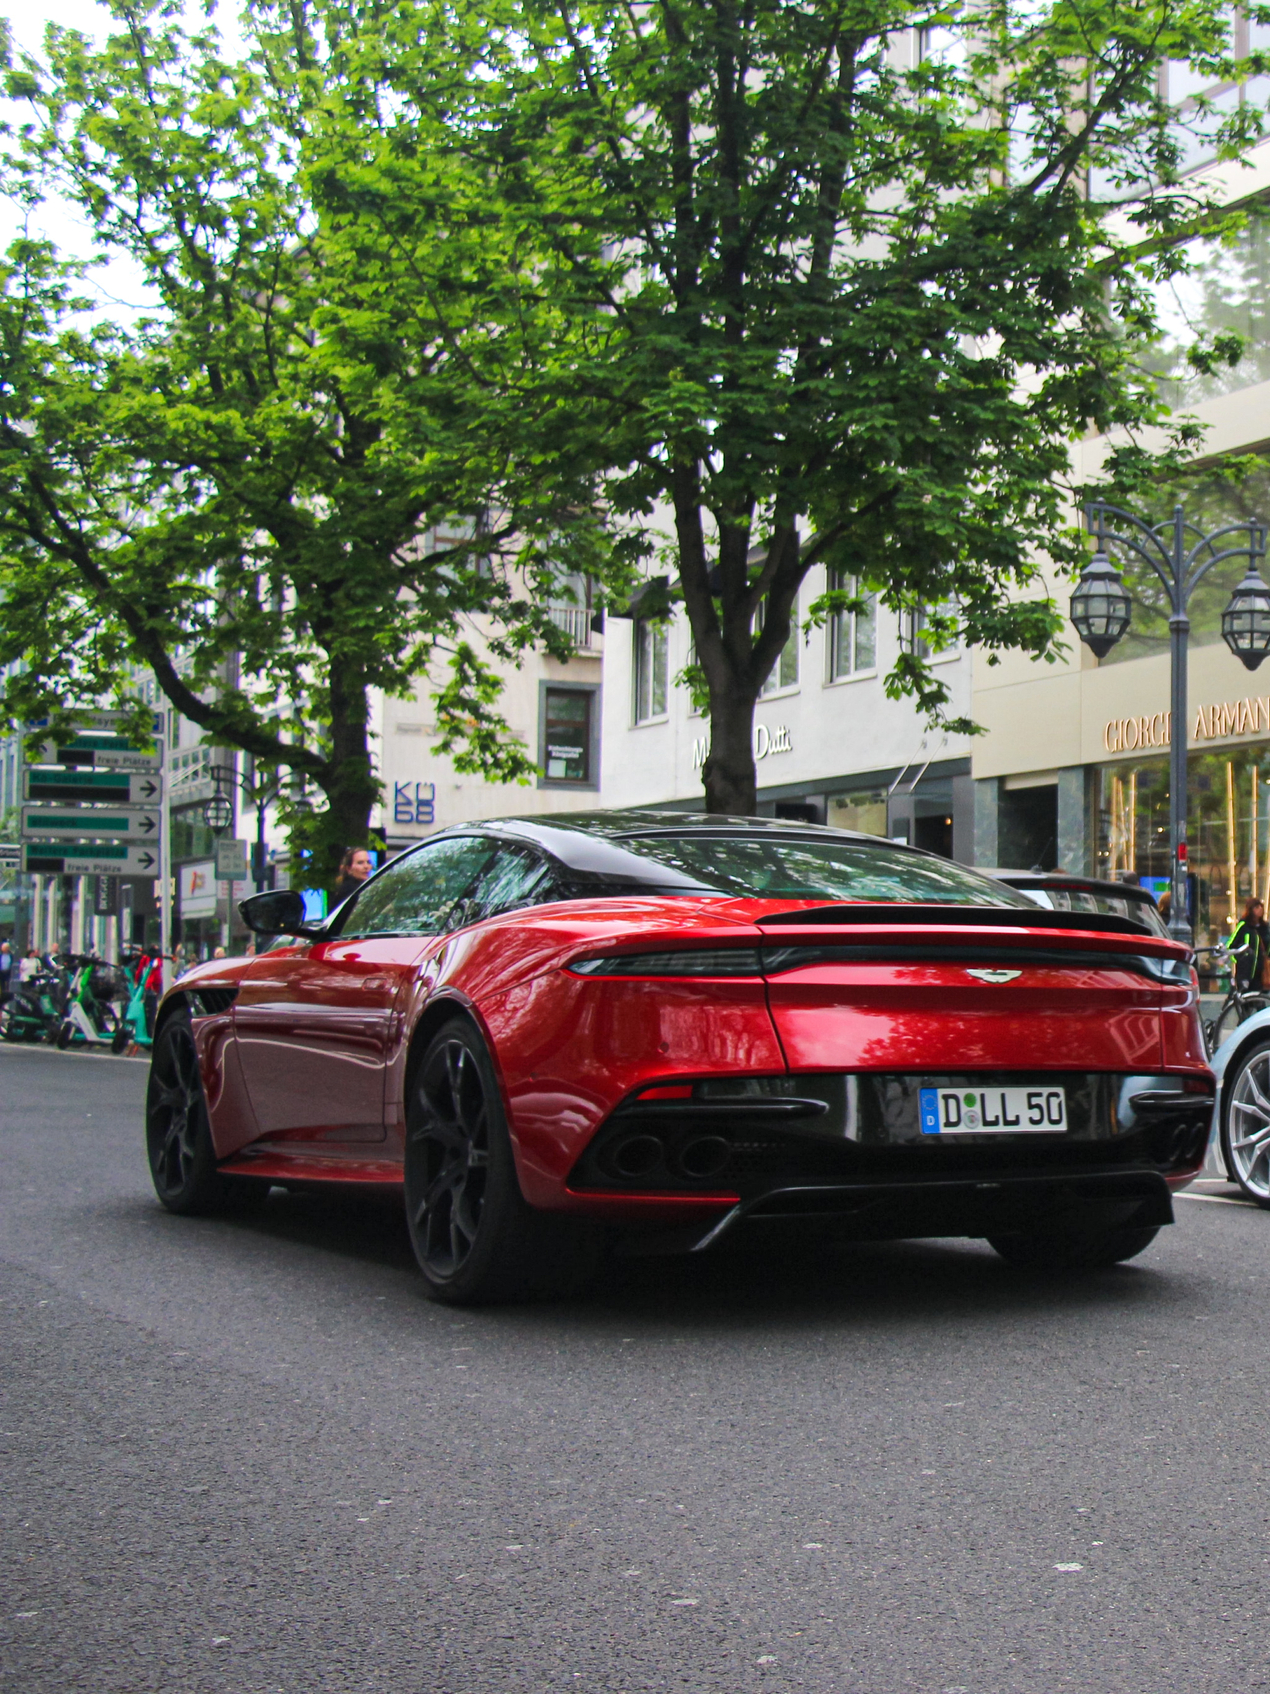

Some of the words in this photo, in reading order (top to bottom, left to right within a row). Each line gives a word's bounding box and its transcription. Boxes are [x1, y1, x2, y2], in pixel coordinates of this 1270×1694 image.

[754, 724, 793, 760] Dutti
[1104, 710, 1172, 754] GIORGI
[926, 1115, 935, 1126] D
[941, 1093, 962, 1128] D
[980, 1092, 1020, 1127] LL
[1026, 1091, 1063, 1126] 50
